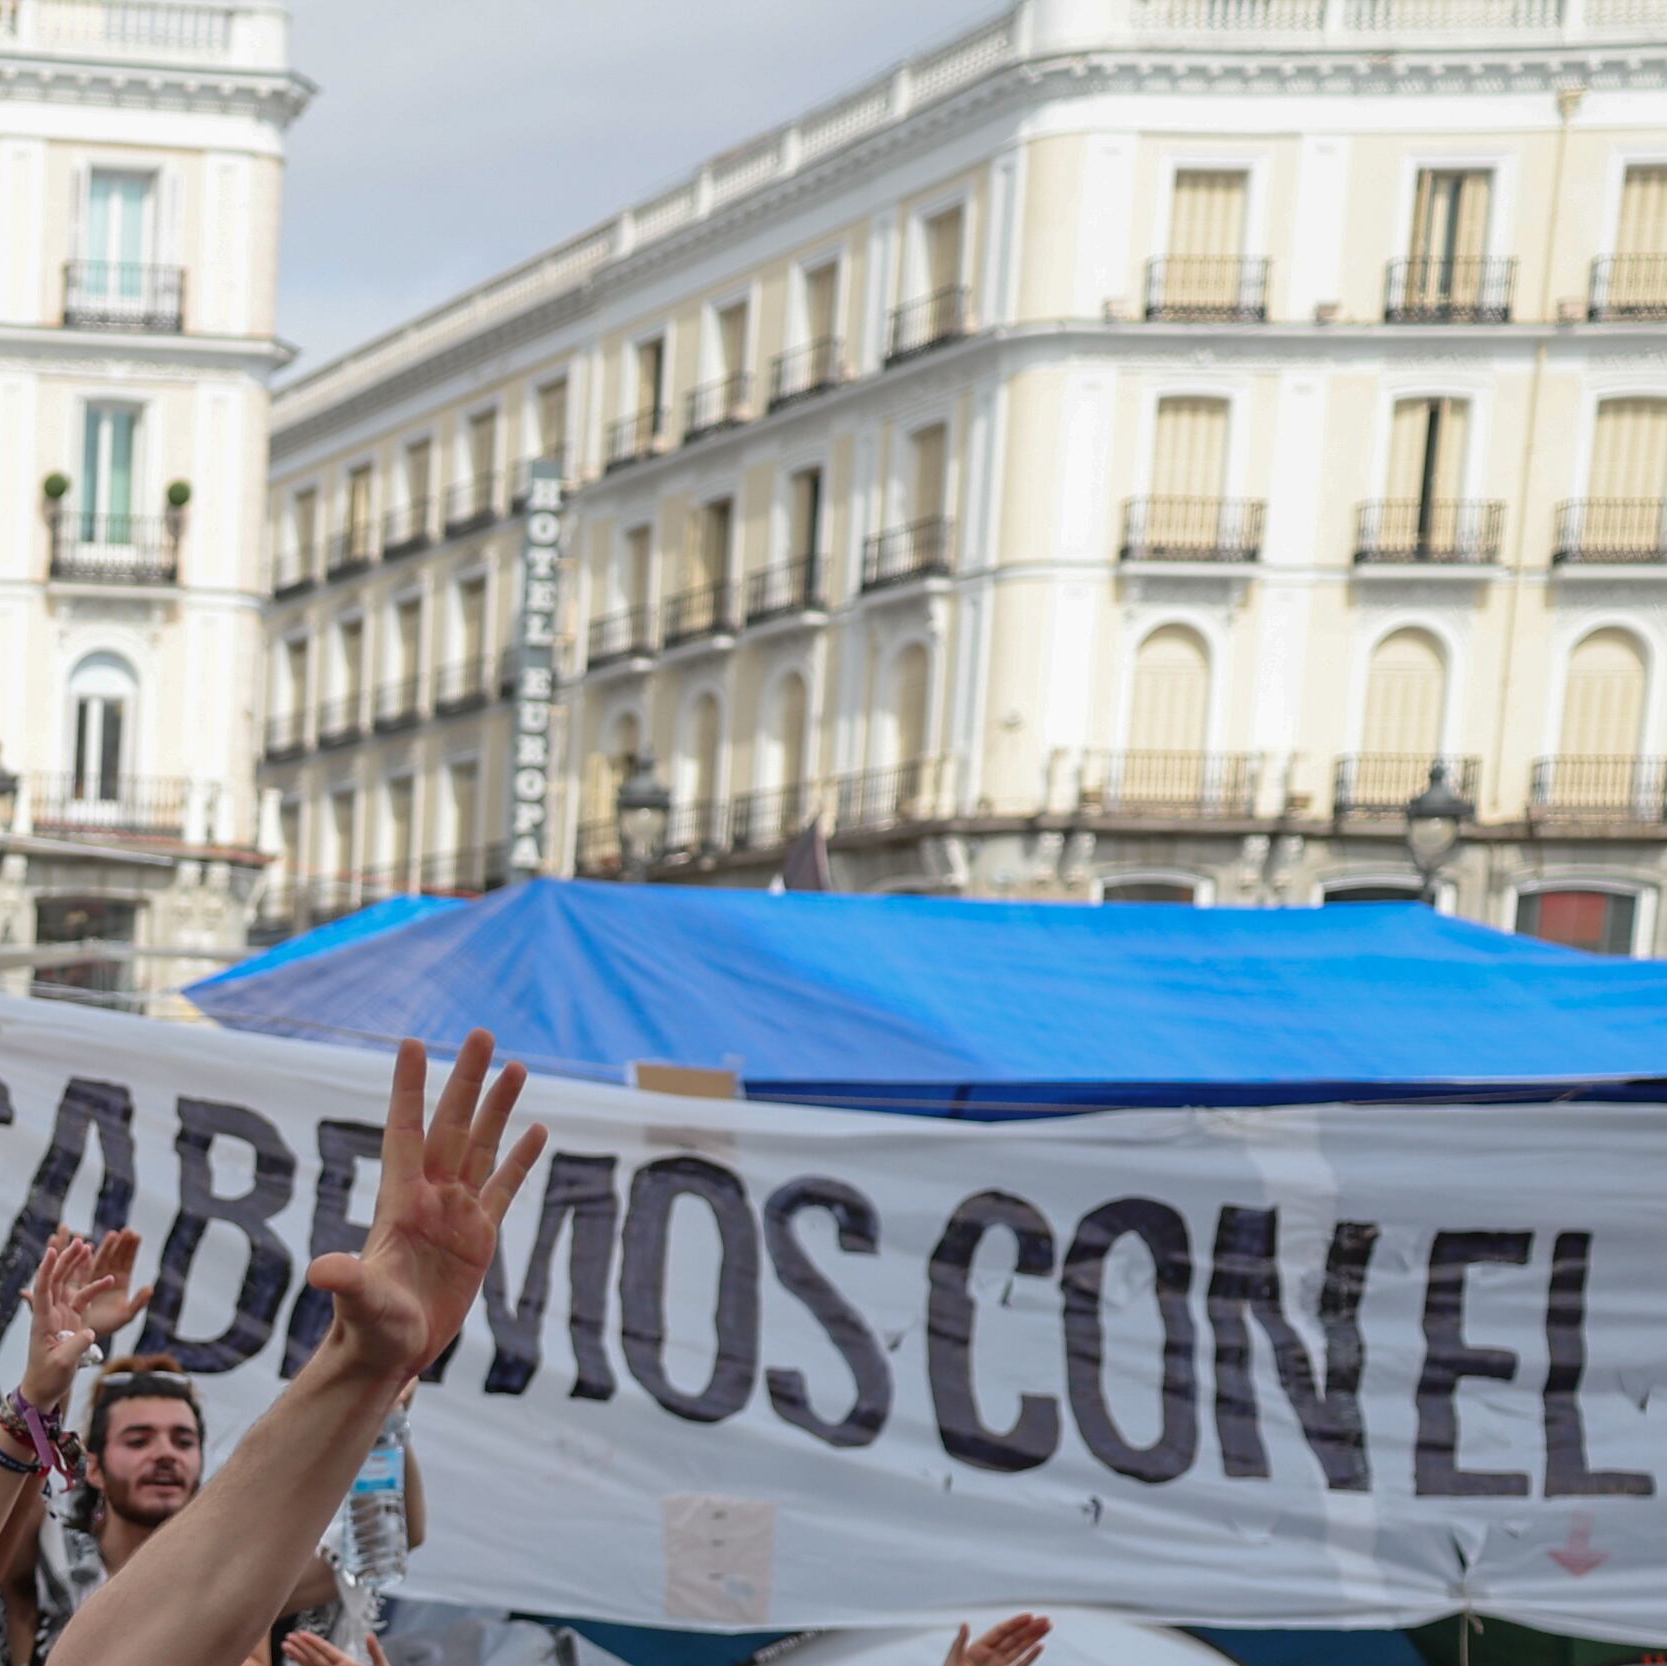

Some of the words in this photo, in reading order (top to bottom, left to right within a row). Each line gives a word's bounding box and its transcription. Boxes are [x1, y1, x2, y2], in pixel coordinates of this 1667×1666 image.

[525, 479, 562, 647] HOTEL
[510, 666, 553, 869] EUROPA
[927, 1190, 1379, 1492] CON
[1415, 1230, 1655, 1497] EL
